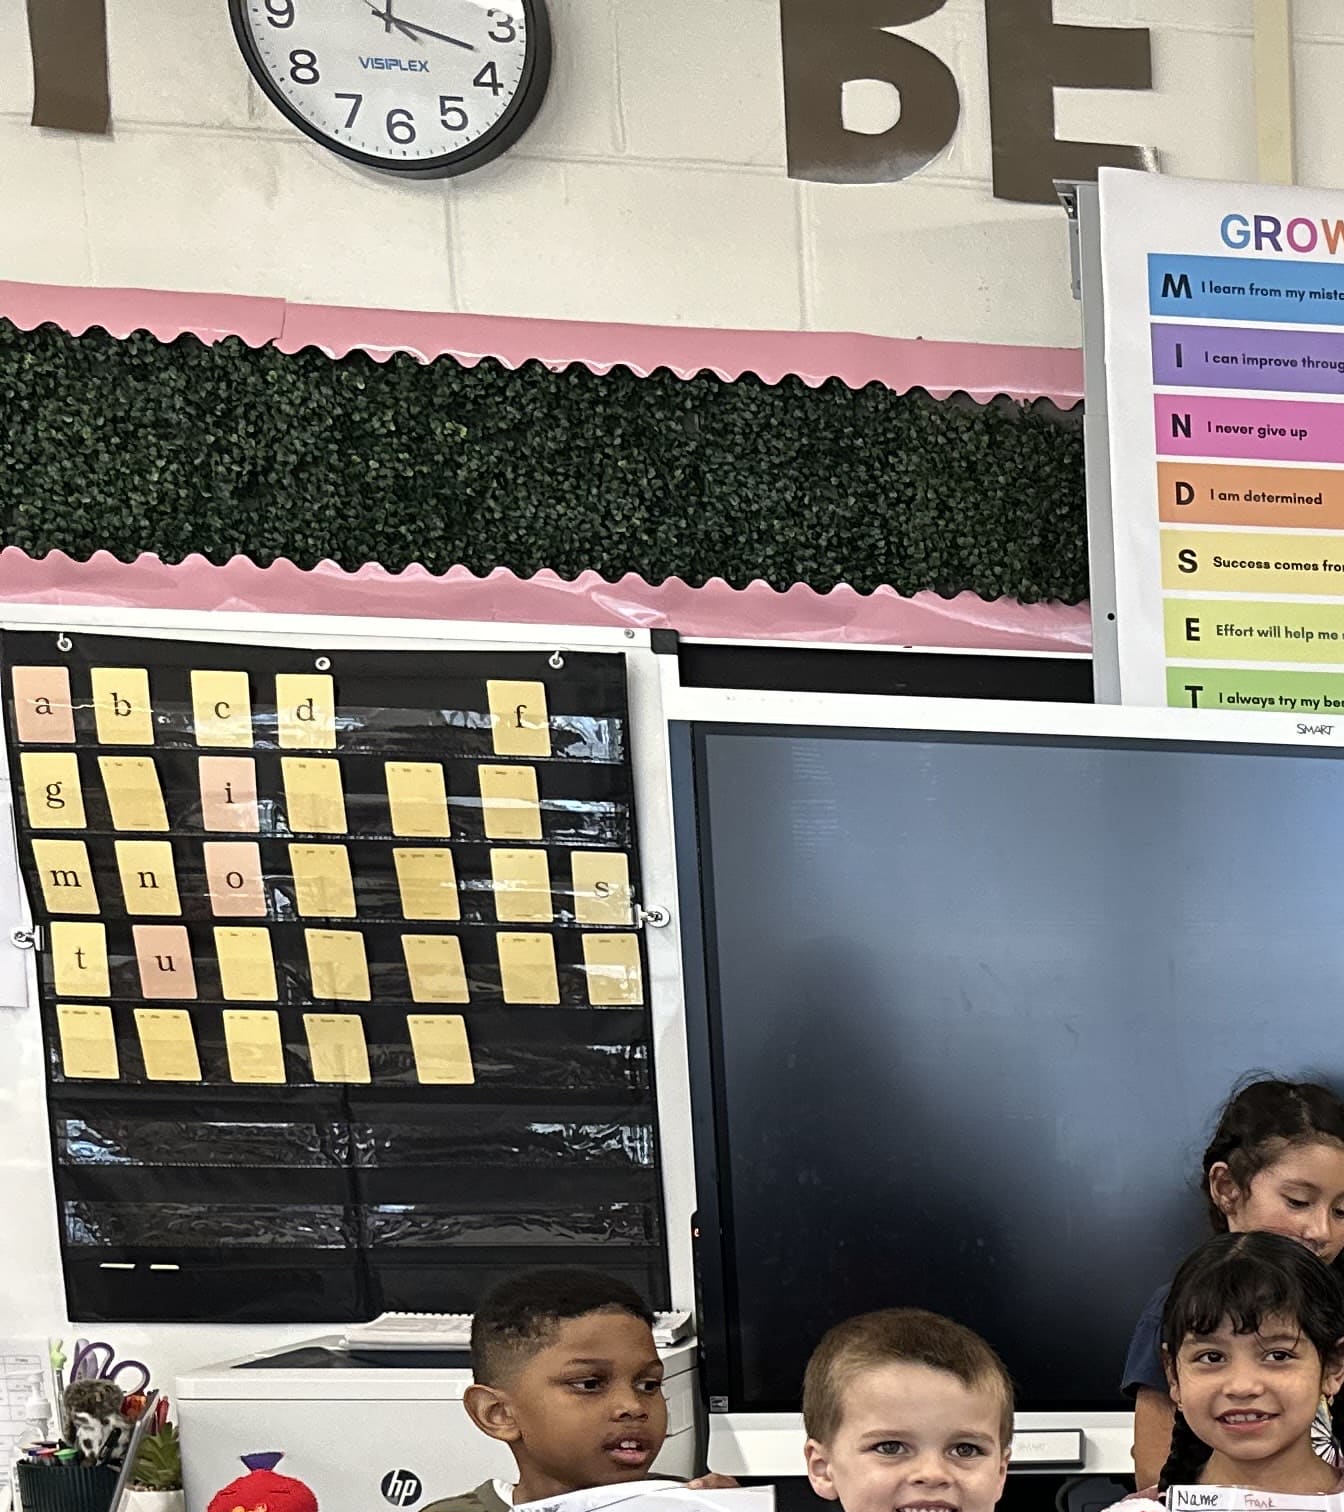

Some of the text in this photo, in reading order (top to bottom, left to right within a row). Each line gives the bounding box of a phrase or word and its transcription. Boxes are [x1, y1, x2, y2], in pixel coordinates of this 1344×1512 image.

[264, 0, 295, 28] 9
[488, 8, 516, 43] 3
[289, 49, 320, 85] 8
[359, 55, 430, 73] VISIPLEX
[473, 61, 504, 96] 4
[334, 93, 363, 129] 7
[439, 95, 469, 132] 5
[781, 0, 1161, 204] BE
[386, 108, 416, 145] 6
[1161, 273, 1193, 300] M
[1208, 281, 1246, 297] learn
[1249, 283, 1281, 299] from
[1285, 288, 1305, 302] my
[1212, 354, 1239, 366] can
[1242, 353, 1298, 370] improve
[1171, 414, 1309, 441] N never give up
[1175, 482, 1323, 506] D am determined
[1177, 549, 1198, 574] S
[1213, 556, 1270, 570] Success
[1274, 559, 1319, 572] comes
[1185, 618, 1201, 641] E
[1216, 624, 1254, 638] Effort
[1257, 625, 1281, 639] will
[1284, 626, 1315, 643] help
[1318, 631, 1338, 641] me
[35, 692, 528, 729] a b c d f
[1184, 685, 1203, 709] T
[1226, 693, 1275, 711] always
[1278, 695, 1298, 711] try
[1300, 697, 1320, 712] my
[1296, 724, 1335, 736] SMART
[46, 781, 235, 809] g i
[50, 866, 610, 899] m n o s
[74, 945, 176, 973] t u
[385, 1469, 420, 1507] hp
